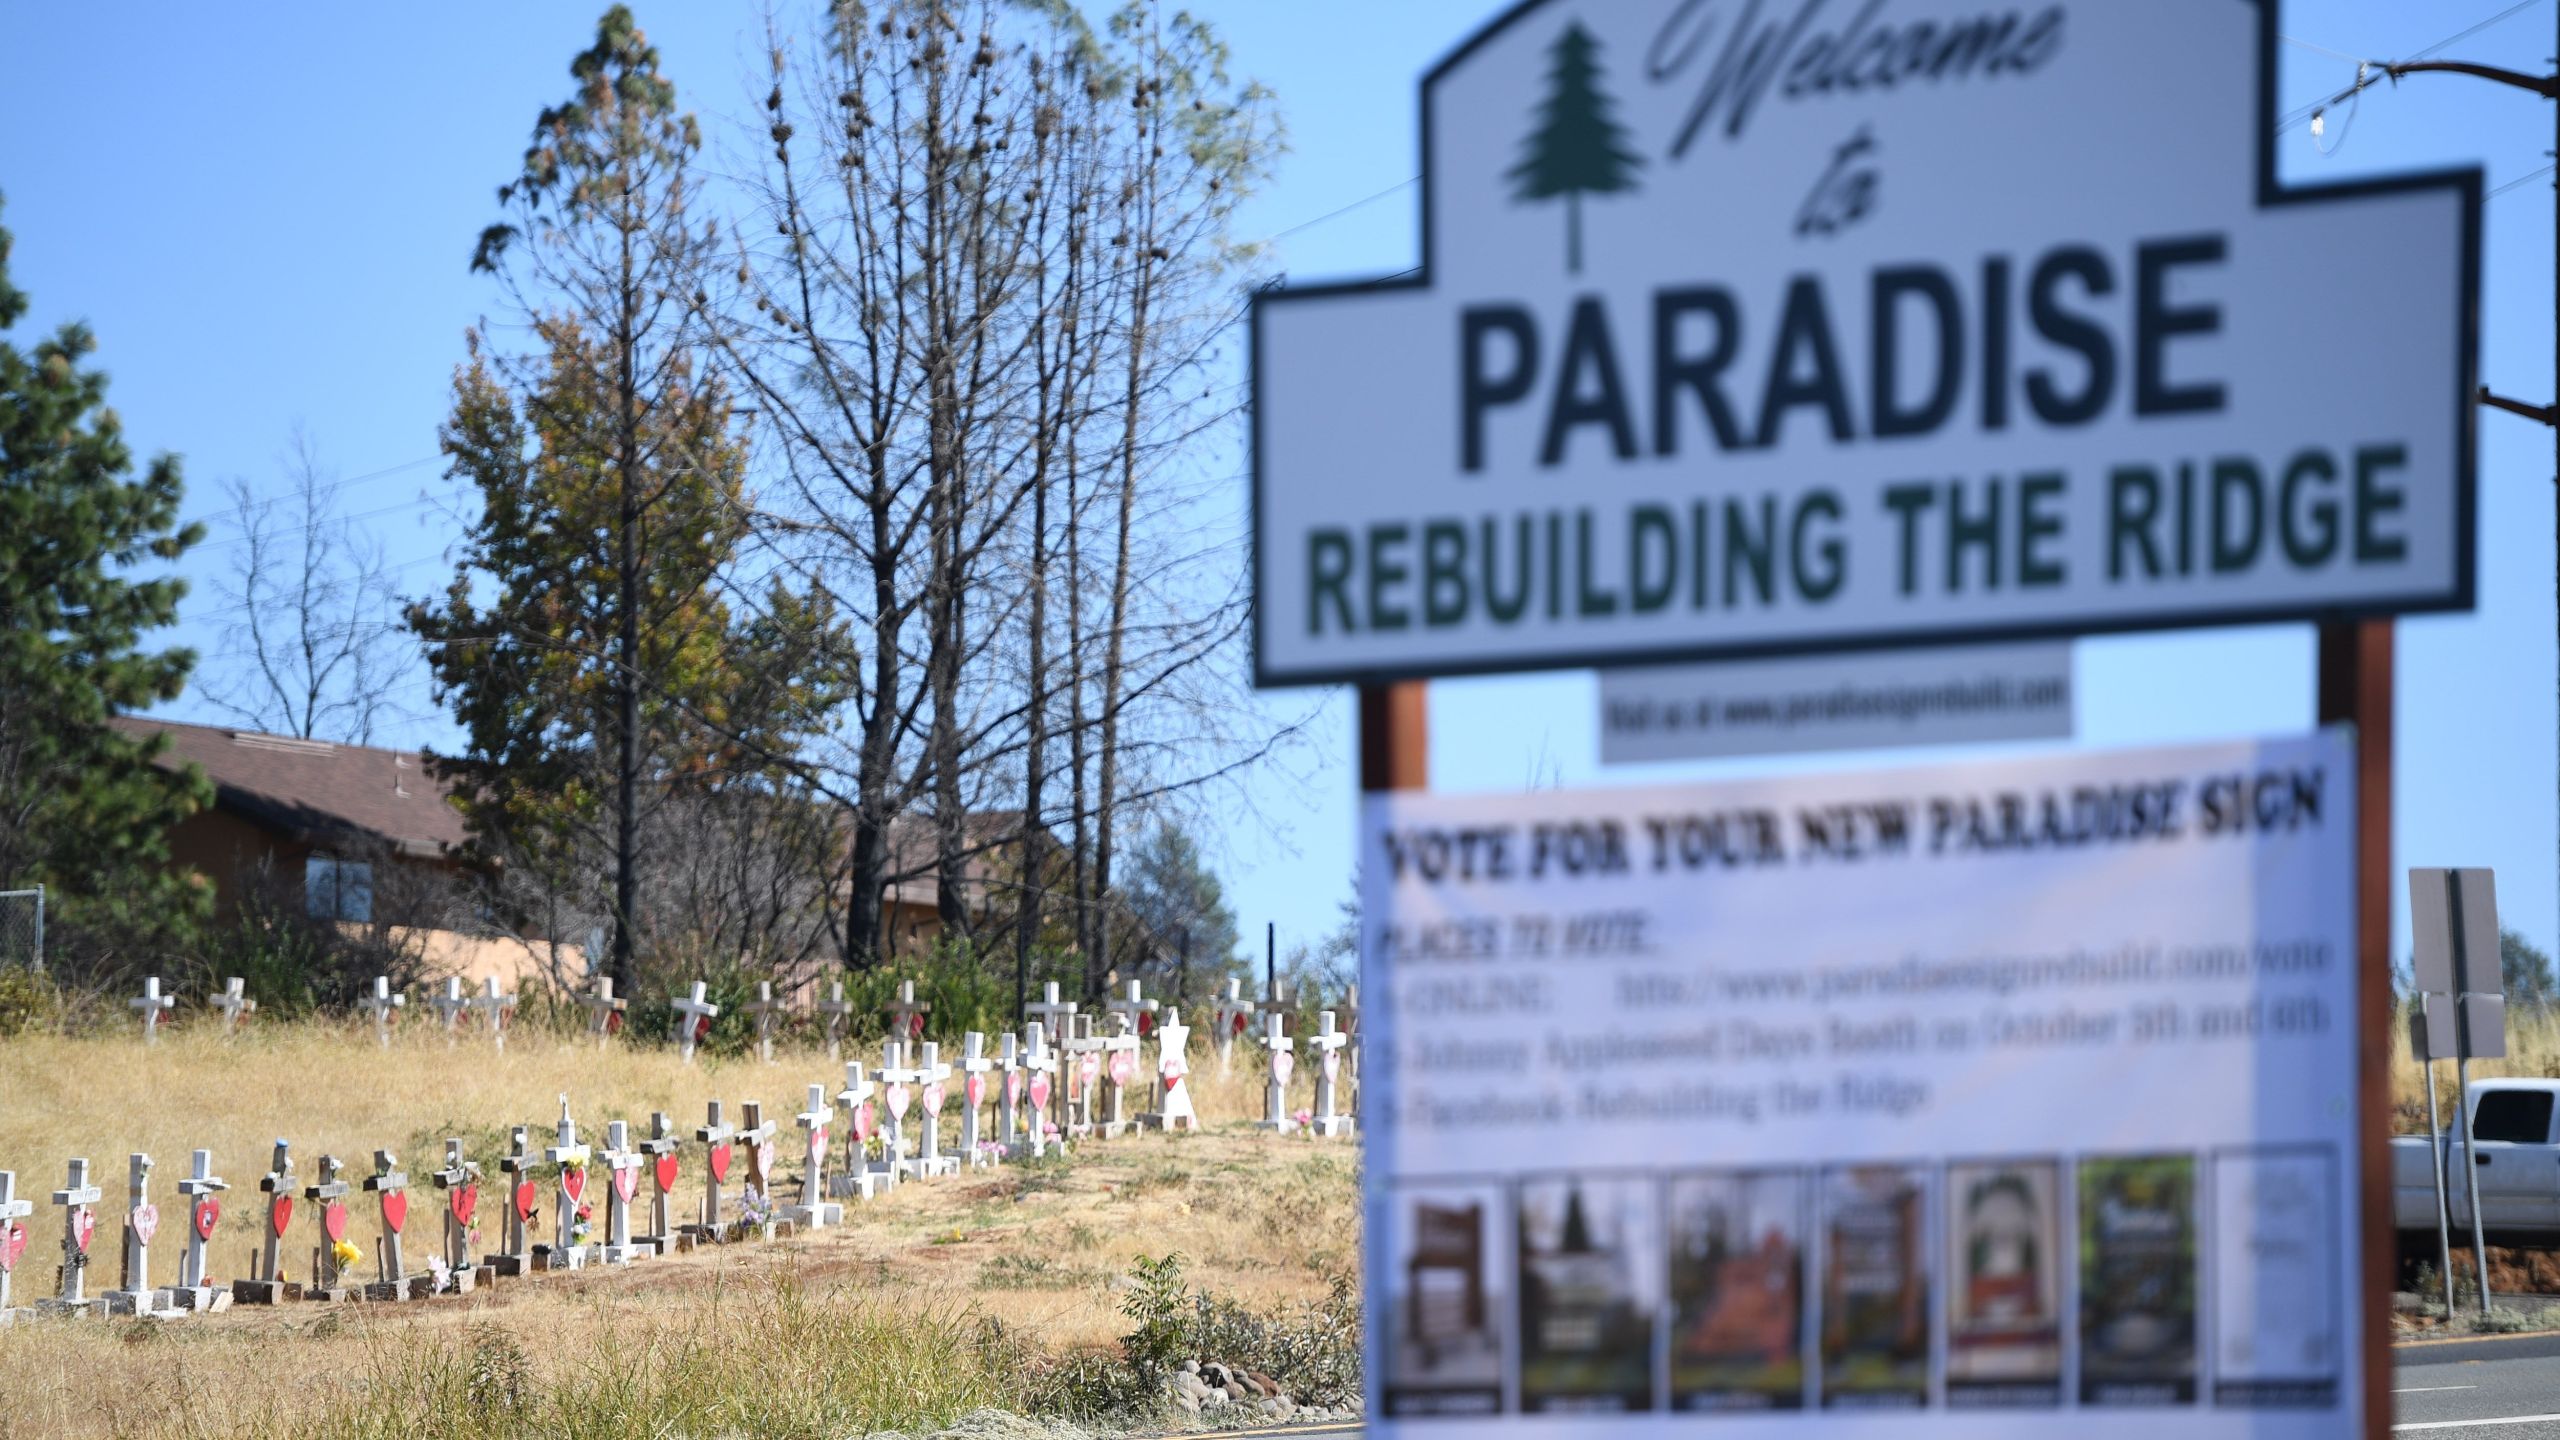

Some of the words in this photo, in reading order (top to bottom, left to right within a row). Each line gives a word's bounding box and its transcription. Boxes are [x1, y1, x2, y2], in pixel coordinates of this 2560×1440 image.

[1643, 0, 2068, 161] Welcome
[1794, 120, 1882, 238] to
[1458, 232, 2228, 473] PARADISE
[1304, 487, 1848, 636] REBUILDING
[1881, 471, 2069, 597] THE
[2107, 442, 2409, 582] RIDGE
[1383, 824, 1516, 881] VOTE
[1531, 817, 1630, 877] FOR
[1643, 809, 1785, 869] YOUR
[1796, 800, 1912, 863] NEW
[1928, 779, 2186, 854] PARADISE
[2201, 765, 2326, 835] SIGN
